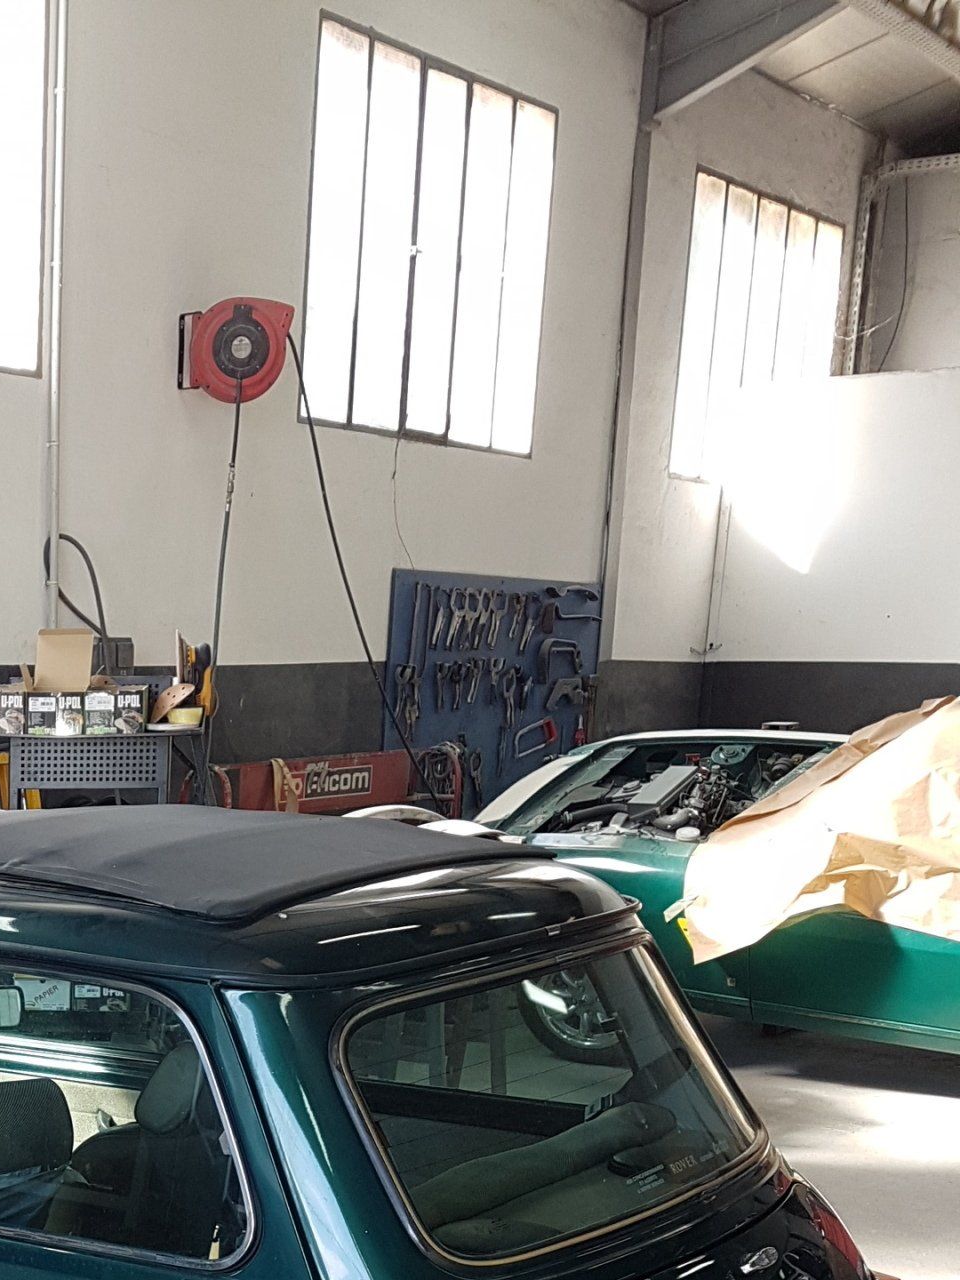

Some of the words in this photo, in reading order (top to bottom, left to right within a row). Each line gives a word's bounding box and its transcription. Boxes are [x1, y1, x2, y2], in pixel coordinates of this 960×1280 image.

[1, 695, 24, 708] U-POL
[58, 696, 82, 709] U-POL
[117, 694, 141, 708] U-POL
[34, 984, 59, 1004] PAPIER
[669, 1154, 698, 1175] ROVER
